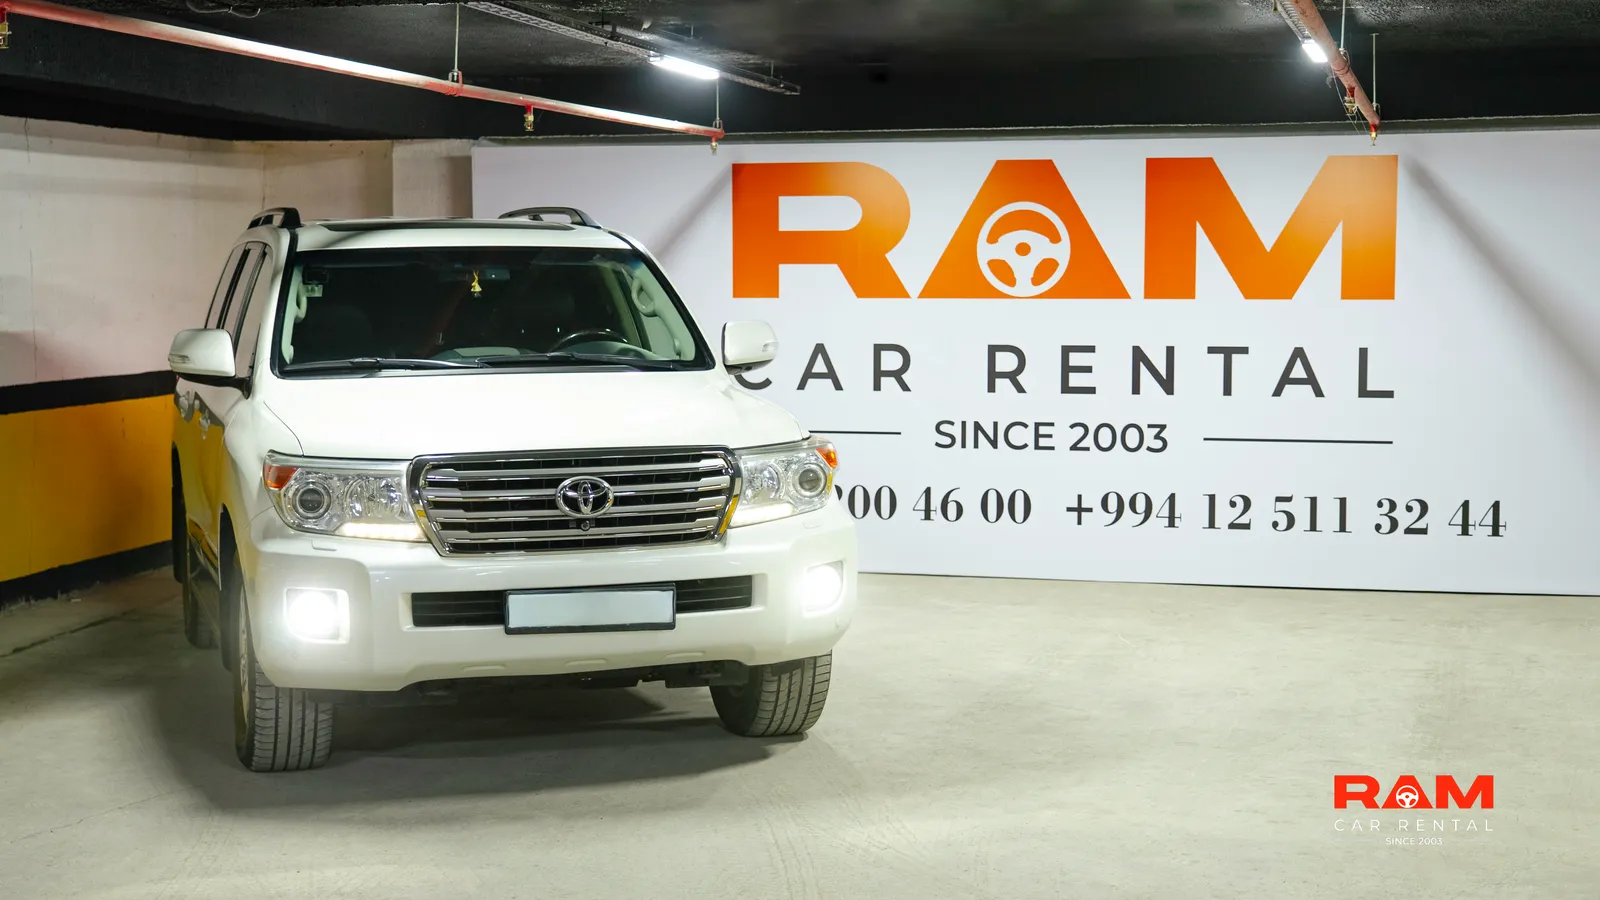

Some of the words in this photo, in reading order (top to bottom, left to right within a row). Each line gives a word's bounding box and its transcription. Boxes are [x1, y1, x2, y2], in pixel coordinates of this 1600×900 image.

[732, 155, 1398, 300] RAM
[987, 344, 1395, 399] RENTAL
[934, 420, 1056, 451] SINCE
[1068, 422, 1168, 454] 2003
[834, 484, 897, 520] 00
[912, 486, 964, 523] 46
[980, 488, 1032, 525] 00
[1065, 491, 1182, 529] +994
[1202, 493, 1252, 531] 12
[1271, 494, 1352, 534] 511
[1374, 497, 1429, 536] 32
[1448, 499, 1507, 538] 44
